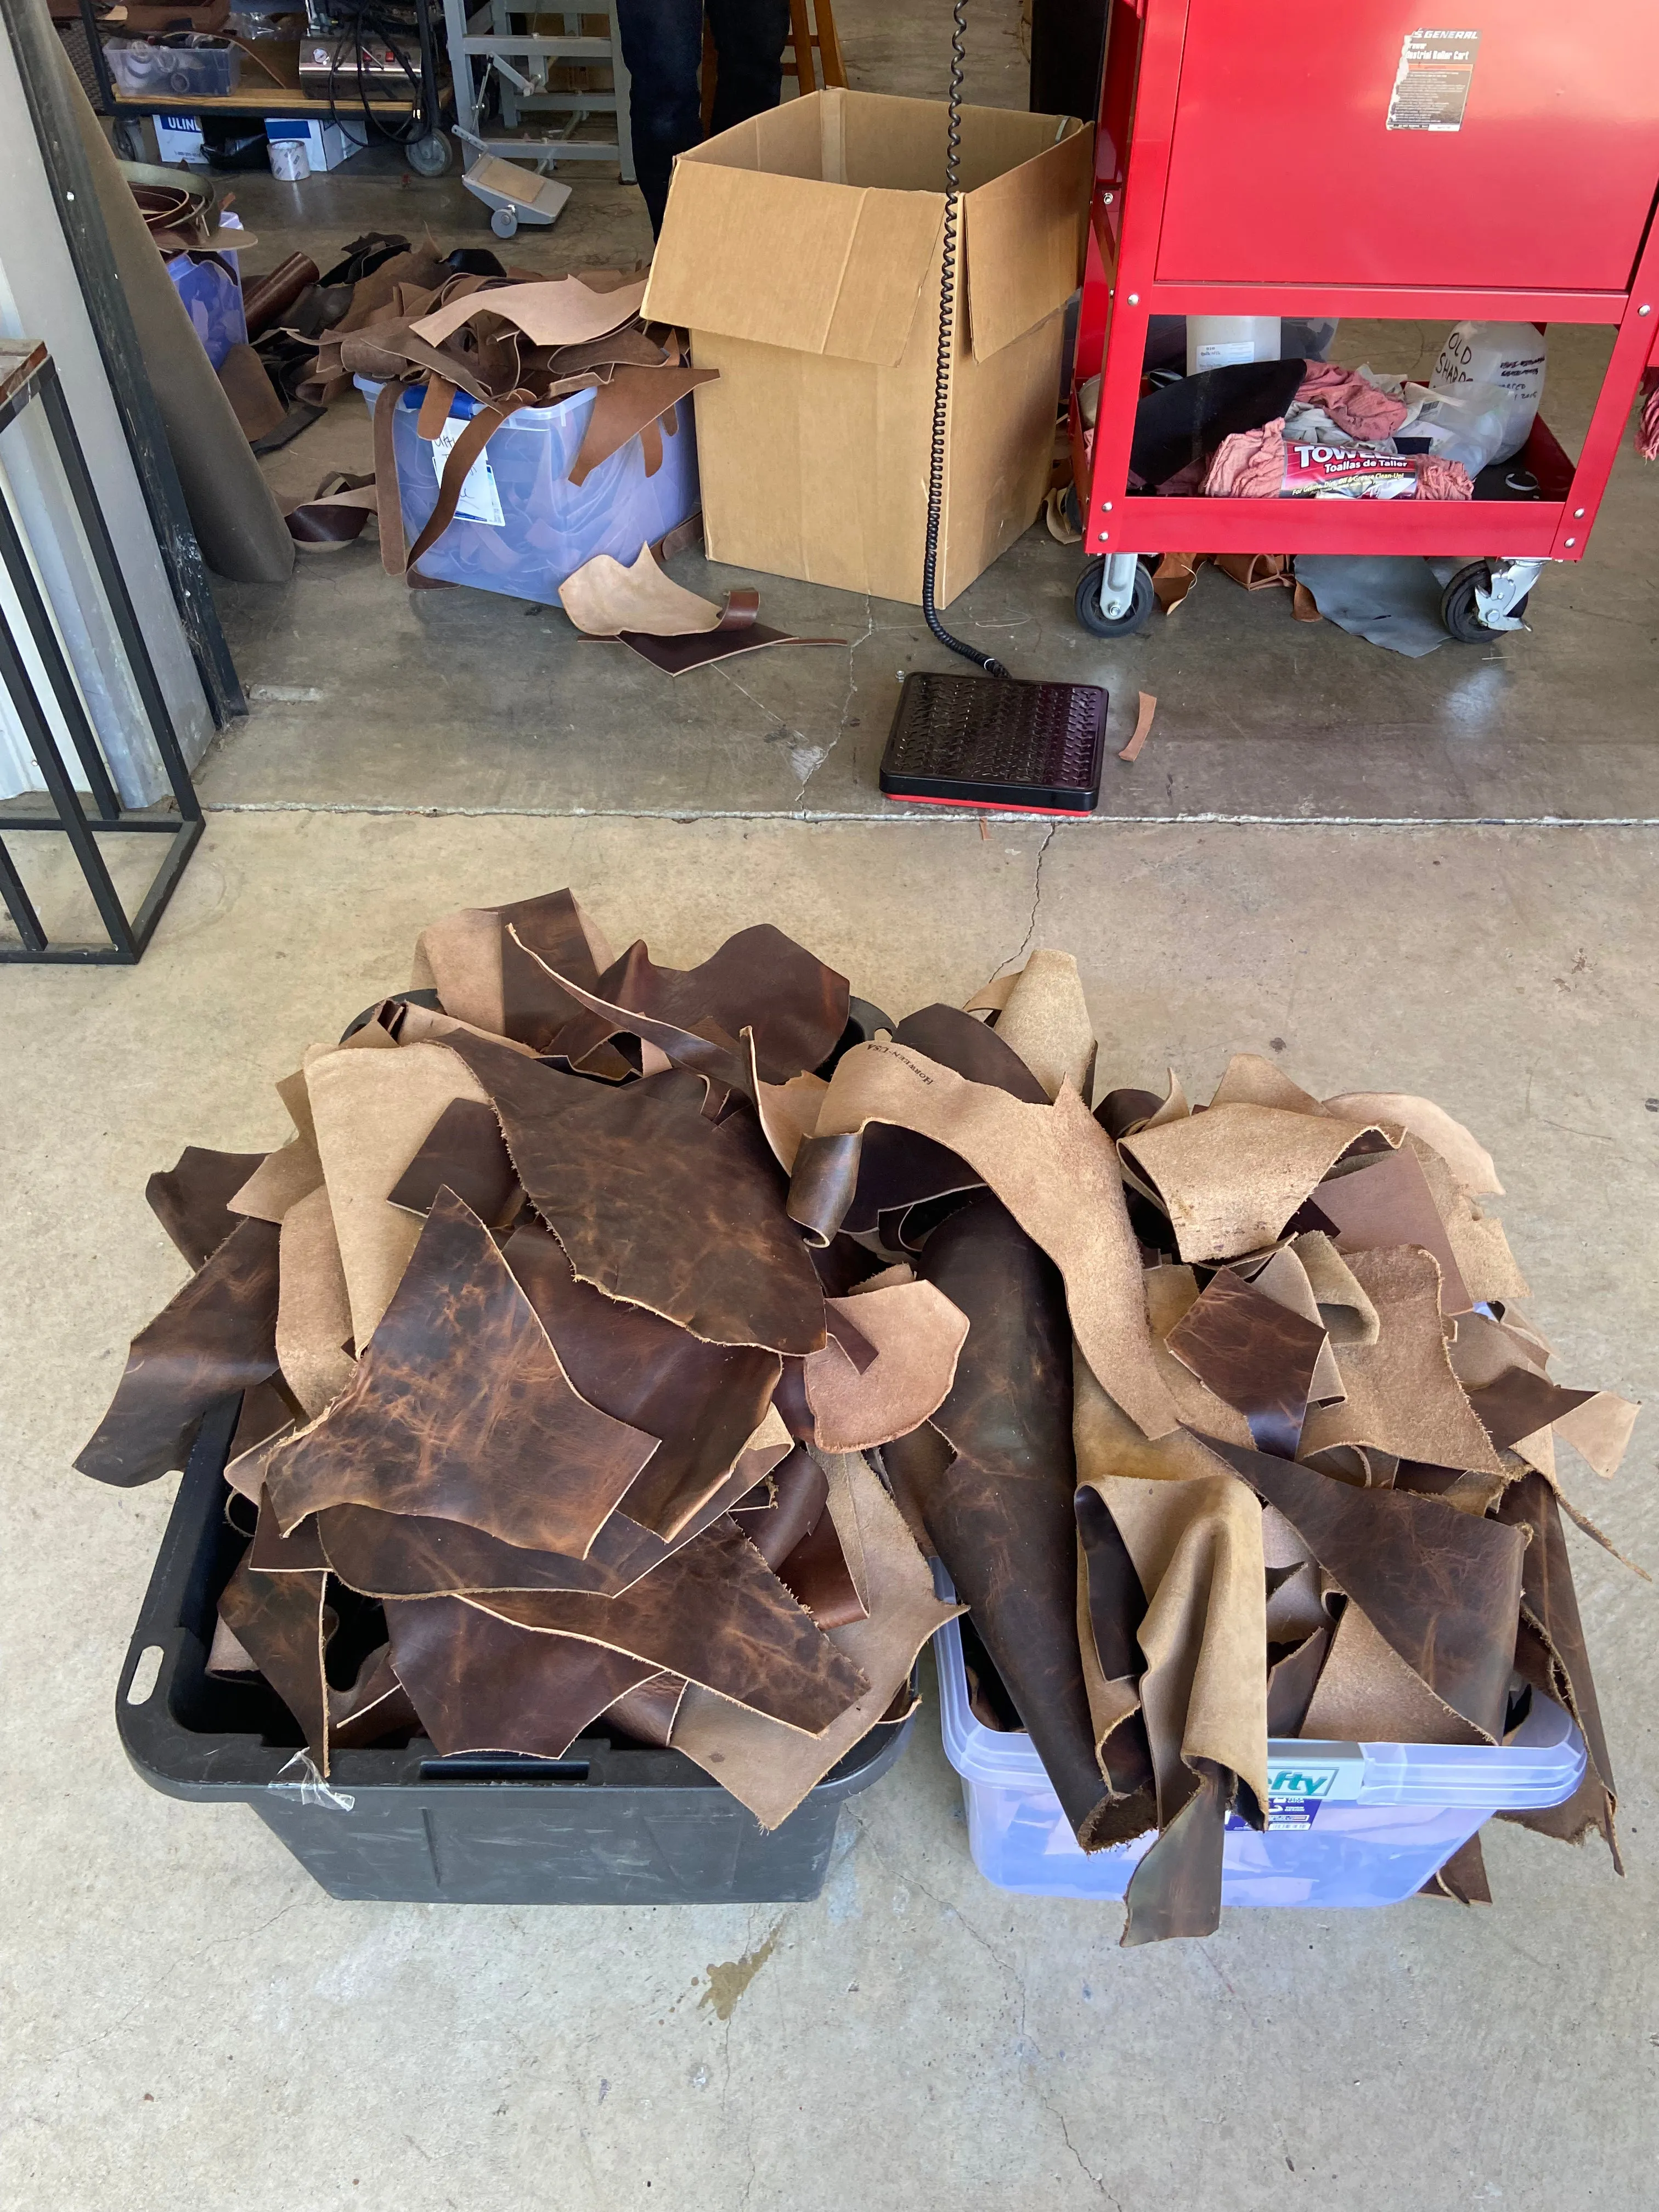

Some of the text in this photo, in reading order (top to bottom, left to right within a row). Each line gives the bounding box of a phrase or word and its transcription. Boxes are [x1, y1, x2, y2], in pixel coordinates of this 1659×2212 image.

[1424, 30, 1478, 39] GENERAL
[1448, 332, 1472, 365] OLD
[1324, 460, 1361, 473] Toallas
[1292, 488, 1303, 496] For
[1268, 1770, 1328, 1796] fty
